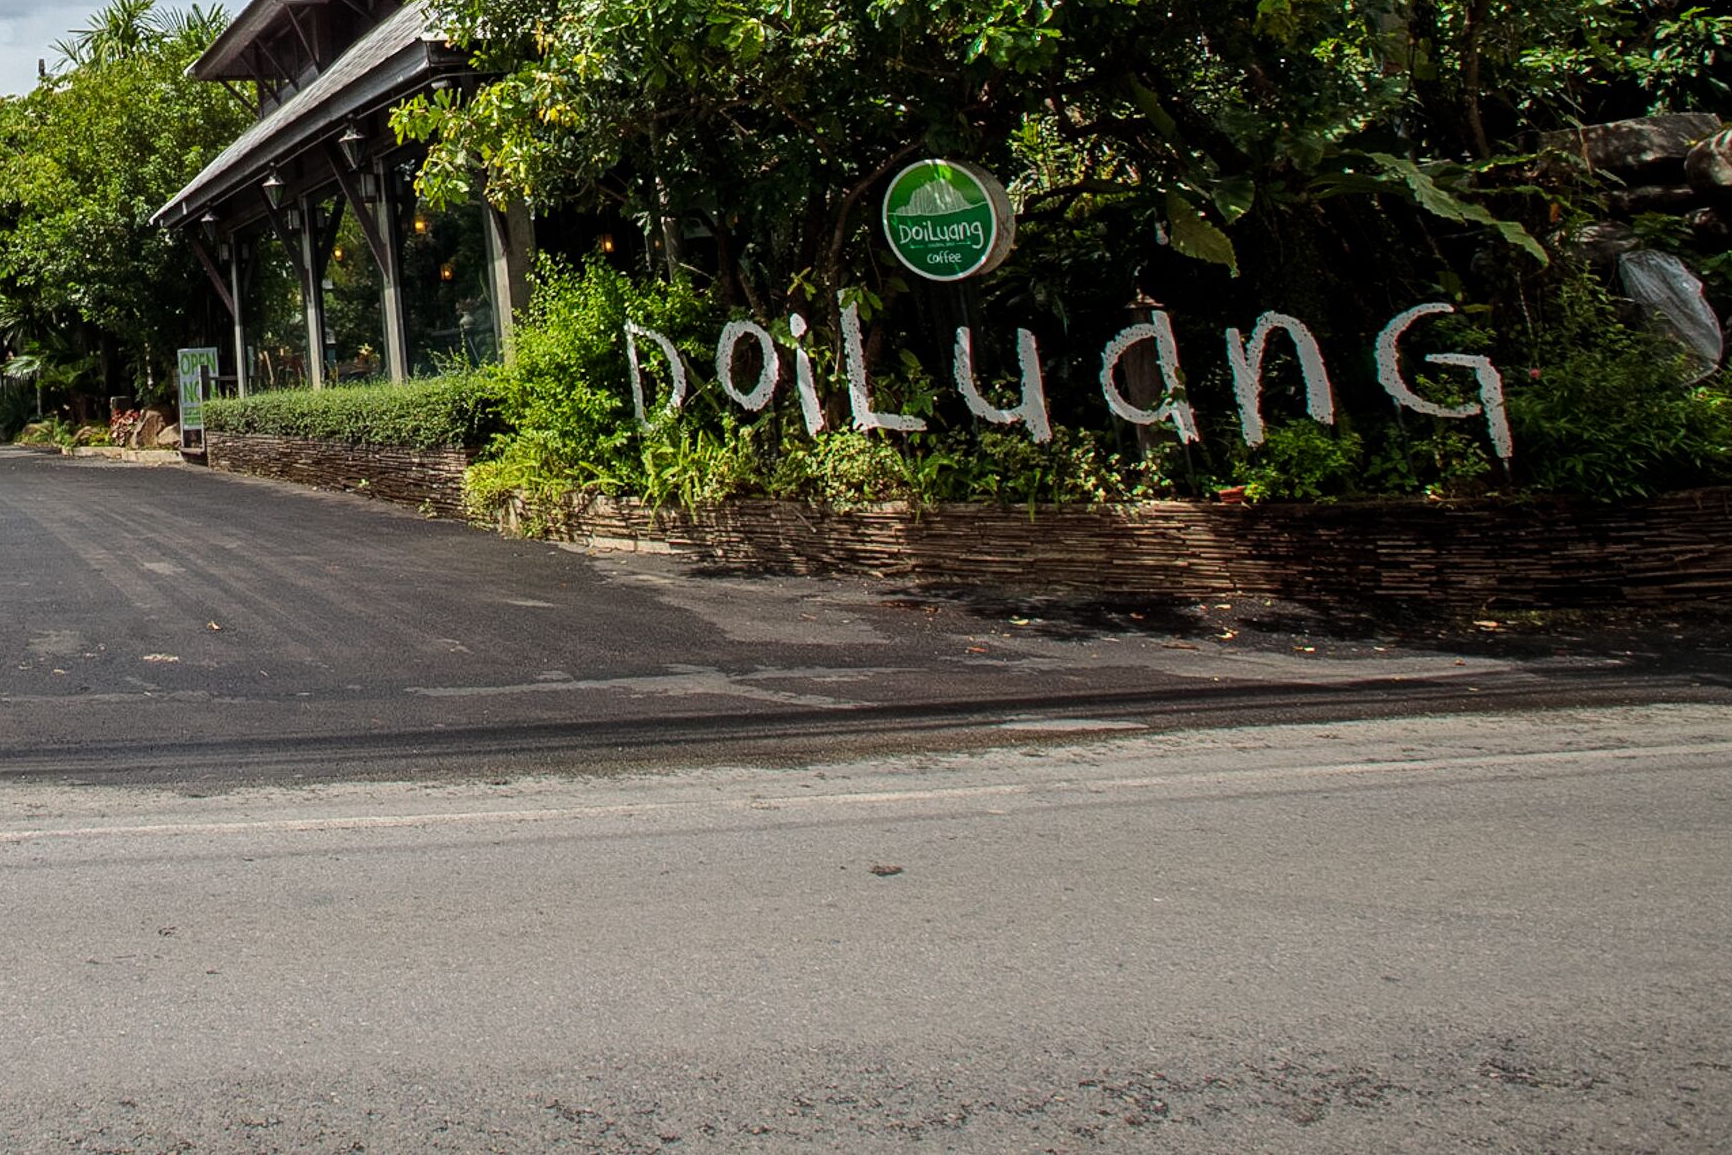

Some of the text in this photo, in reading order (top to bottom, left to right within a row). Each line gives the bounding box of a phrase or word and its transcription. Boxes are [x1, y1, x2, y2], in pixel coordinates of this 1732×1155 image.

[898, 220, 985, 250] DoiLuang
[926, 249, 963, 264] coffee
[180, 352, 217, 376] OPEN
